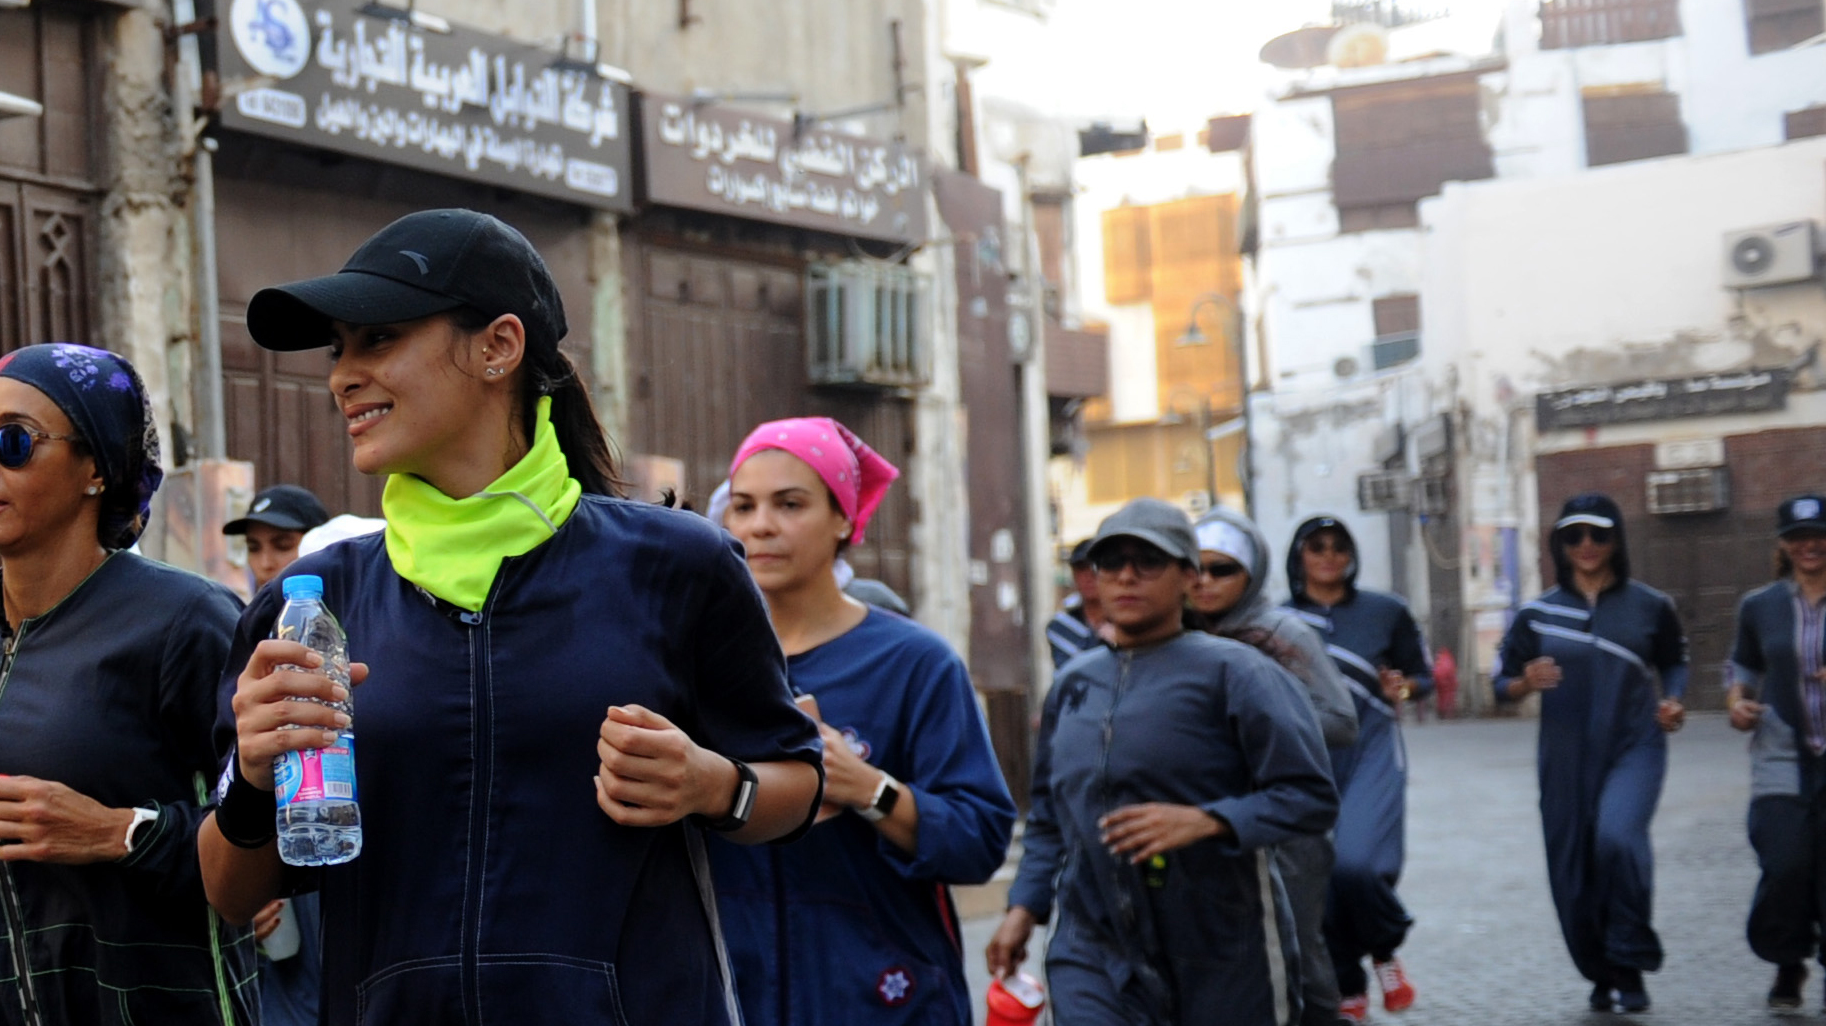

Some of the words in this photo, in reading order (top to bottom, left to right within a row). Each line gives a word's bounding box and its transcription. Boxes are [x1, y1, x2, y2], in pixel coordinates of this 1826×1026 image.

[315, 9, 409, 93] التجارية
[409, 34, 489, 114] العربية
[490, 53, 560, 131] التوابل
[561, 74, 618, 147] شركة
[854, 146, 918, 196] المركز
